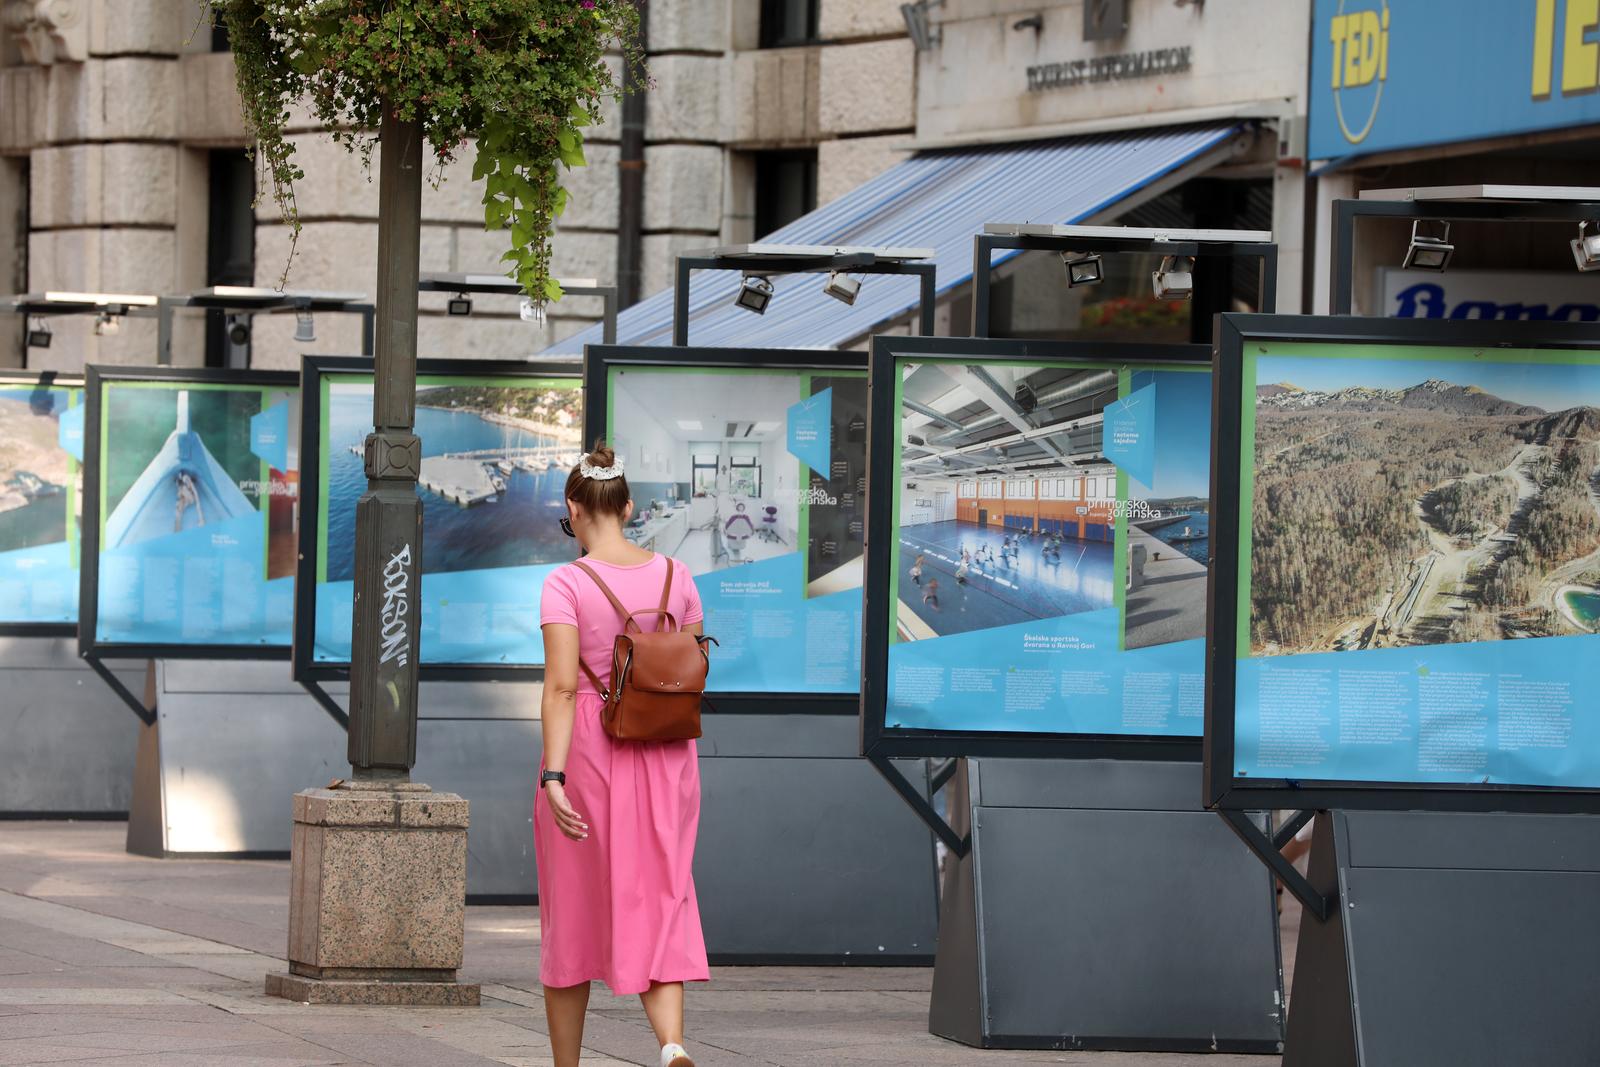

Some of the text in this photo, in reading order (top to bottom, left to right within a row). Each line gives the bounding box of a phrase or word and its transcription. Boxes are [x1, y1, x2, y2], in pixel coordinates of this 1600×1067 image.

[1331, 7, 1390, 89] TEDi
[1027, 46, 1192, 91] TOURIST INFORMATION
[1087, 497, 1148, 511] primorsko
[1107, 505, 1161, 520] goranska
